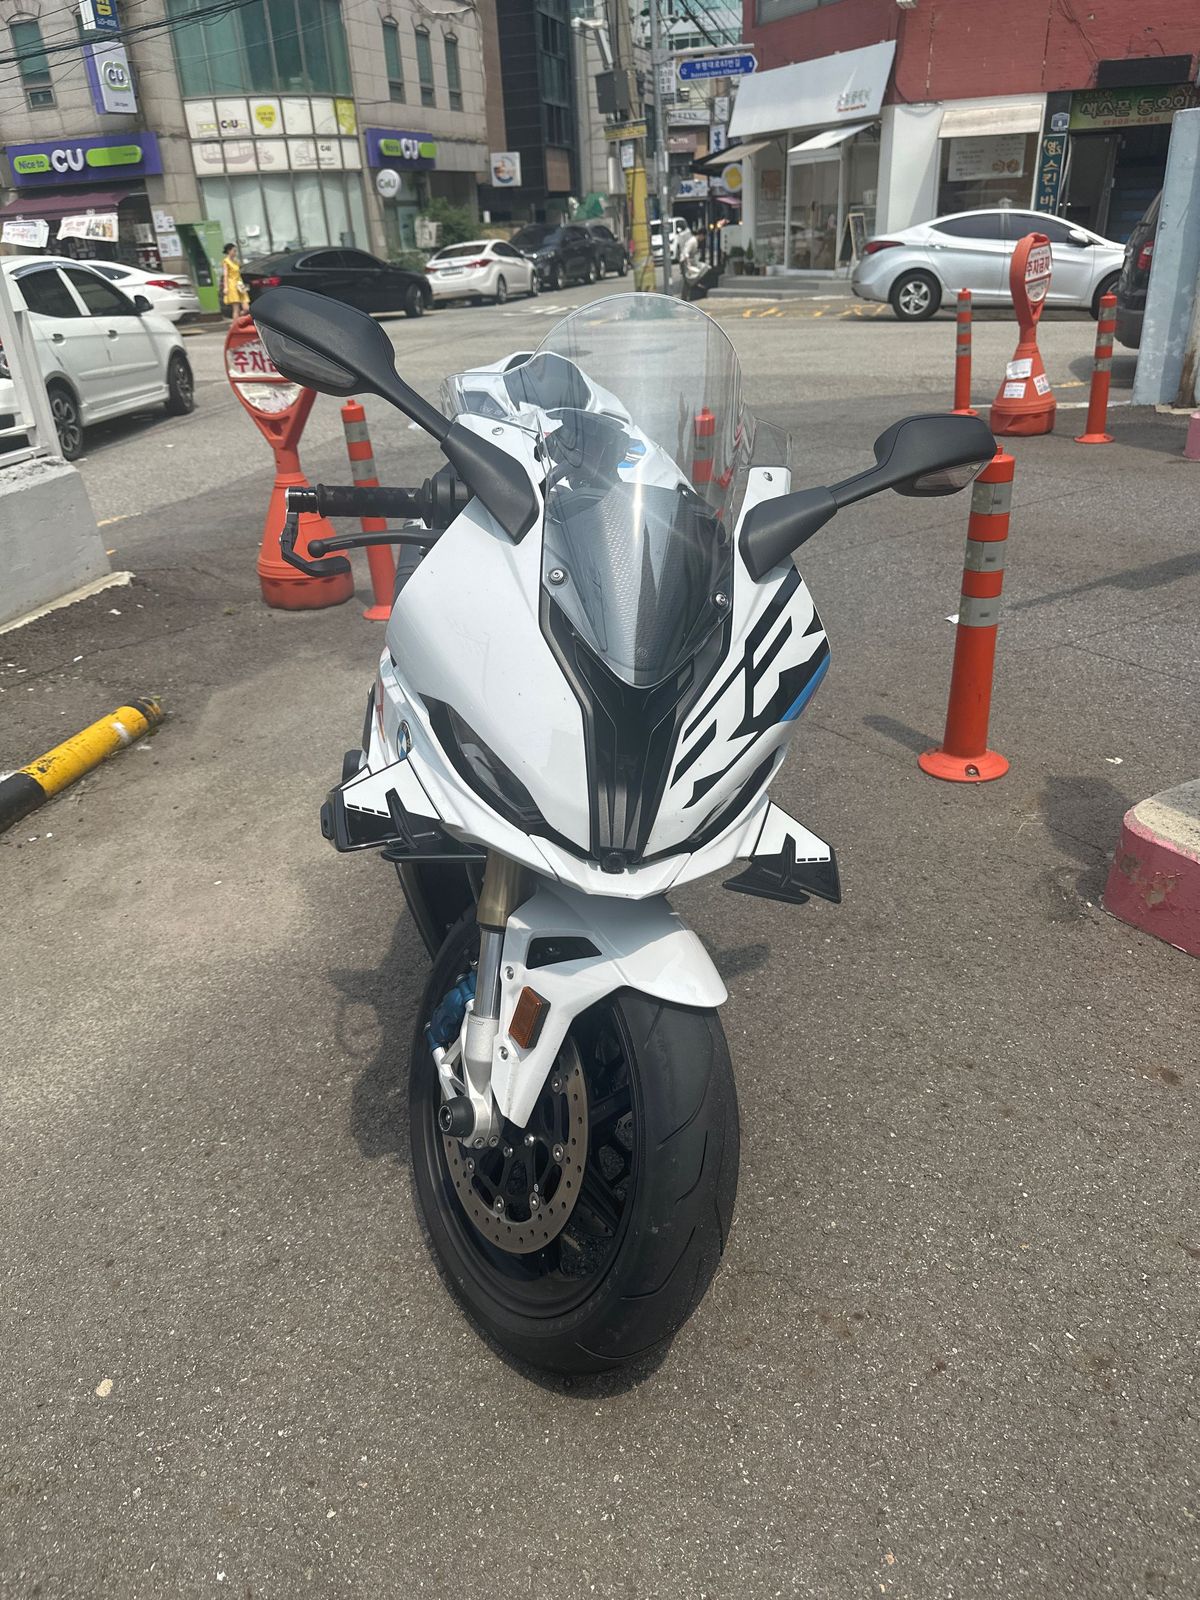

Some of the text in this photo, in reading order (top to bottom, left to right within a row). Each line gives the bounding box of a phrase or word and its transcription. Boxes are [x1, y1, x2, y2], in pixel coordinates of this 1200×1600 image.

[107, 68, 125, 82] CU
[18, 147, 85, 173] Nice to CU
[400, 137, 419, 160] CU
